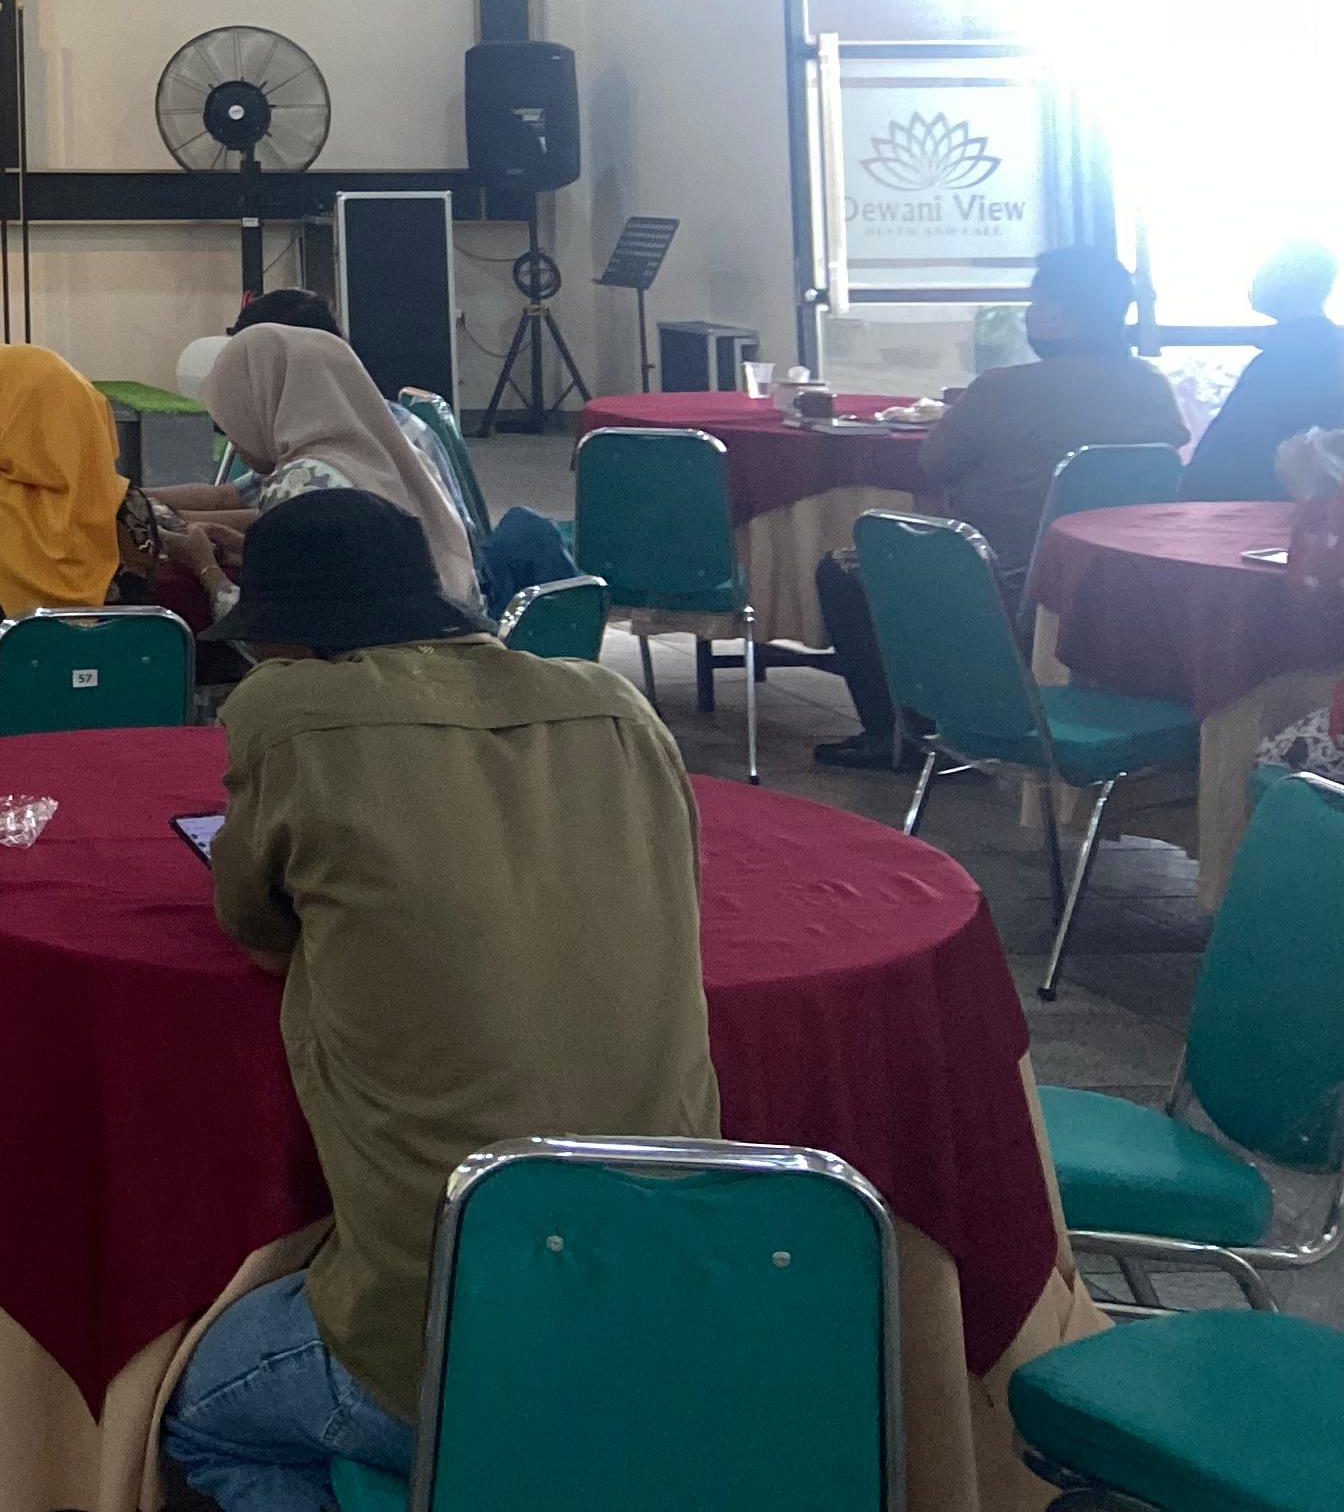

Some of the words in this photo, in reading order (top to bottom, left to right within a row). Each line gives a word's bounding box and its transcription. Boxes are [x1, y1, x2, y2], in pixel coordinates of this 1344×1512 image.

[844, 194, 942, 223] Dewani
[952, 194, 1026, 222] View
[78, 673, 92, 684] 57
